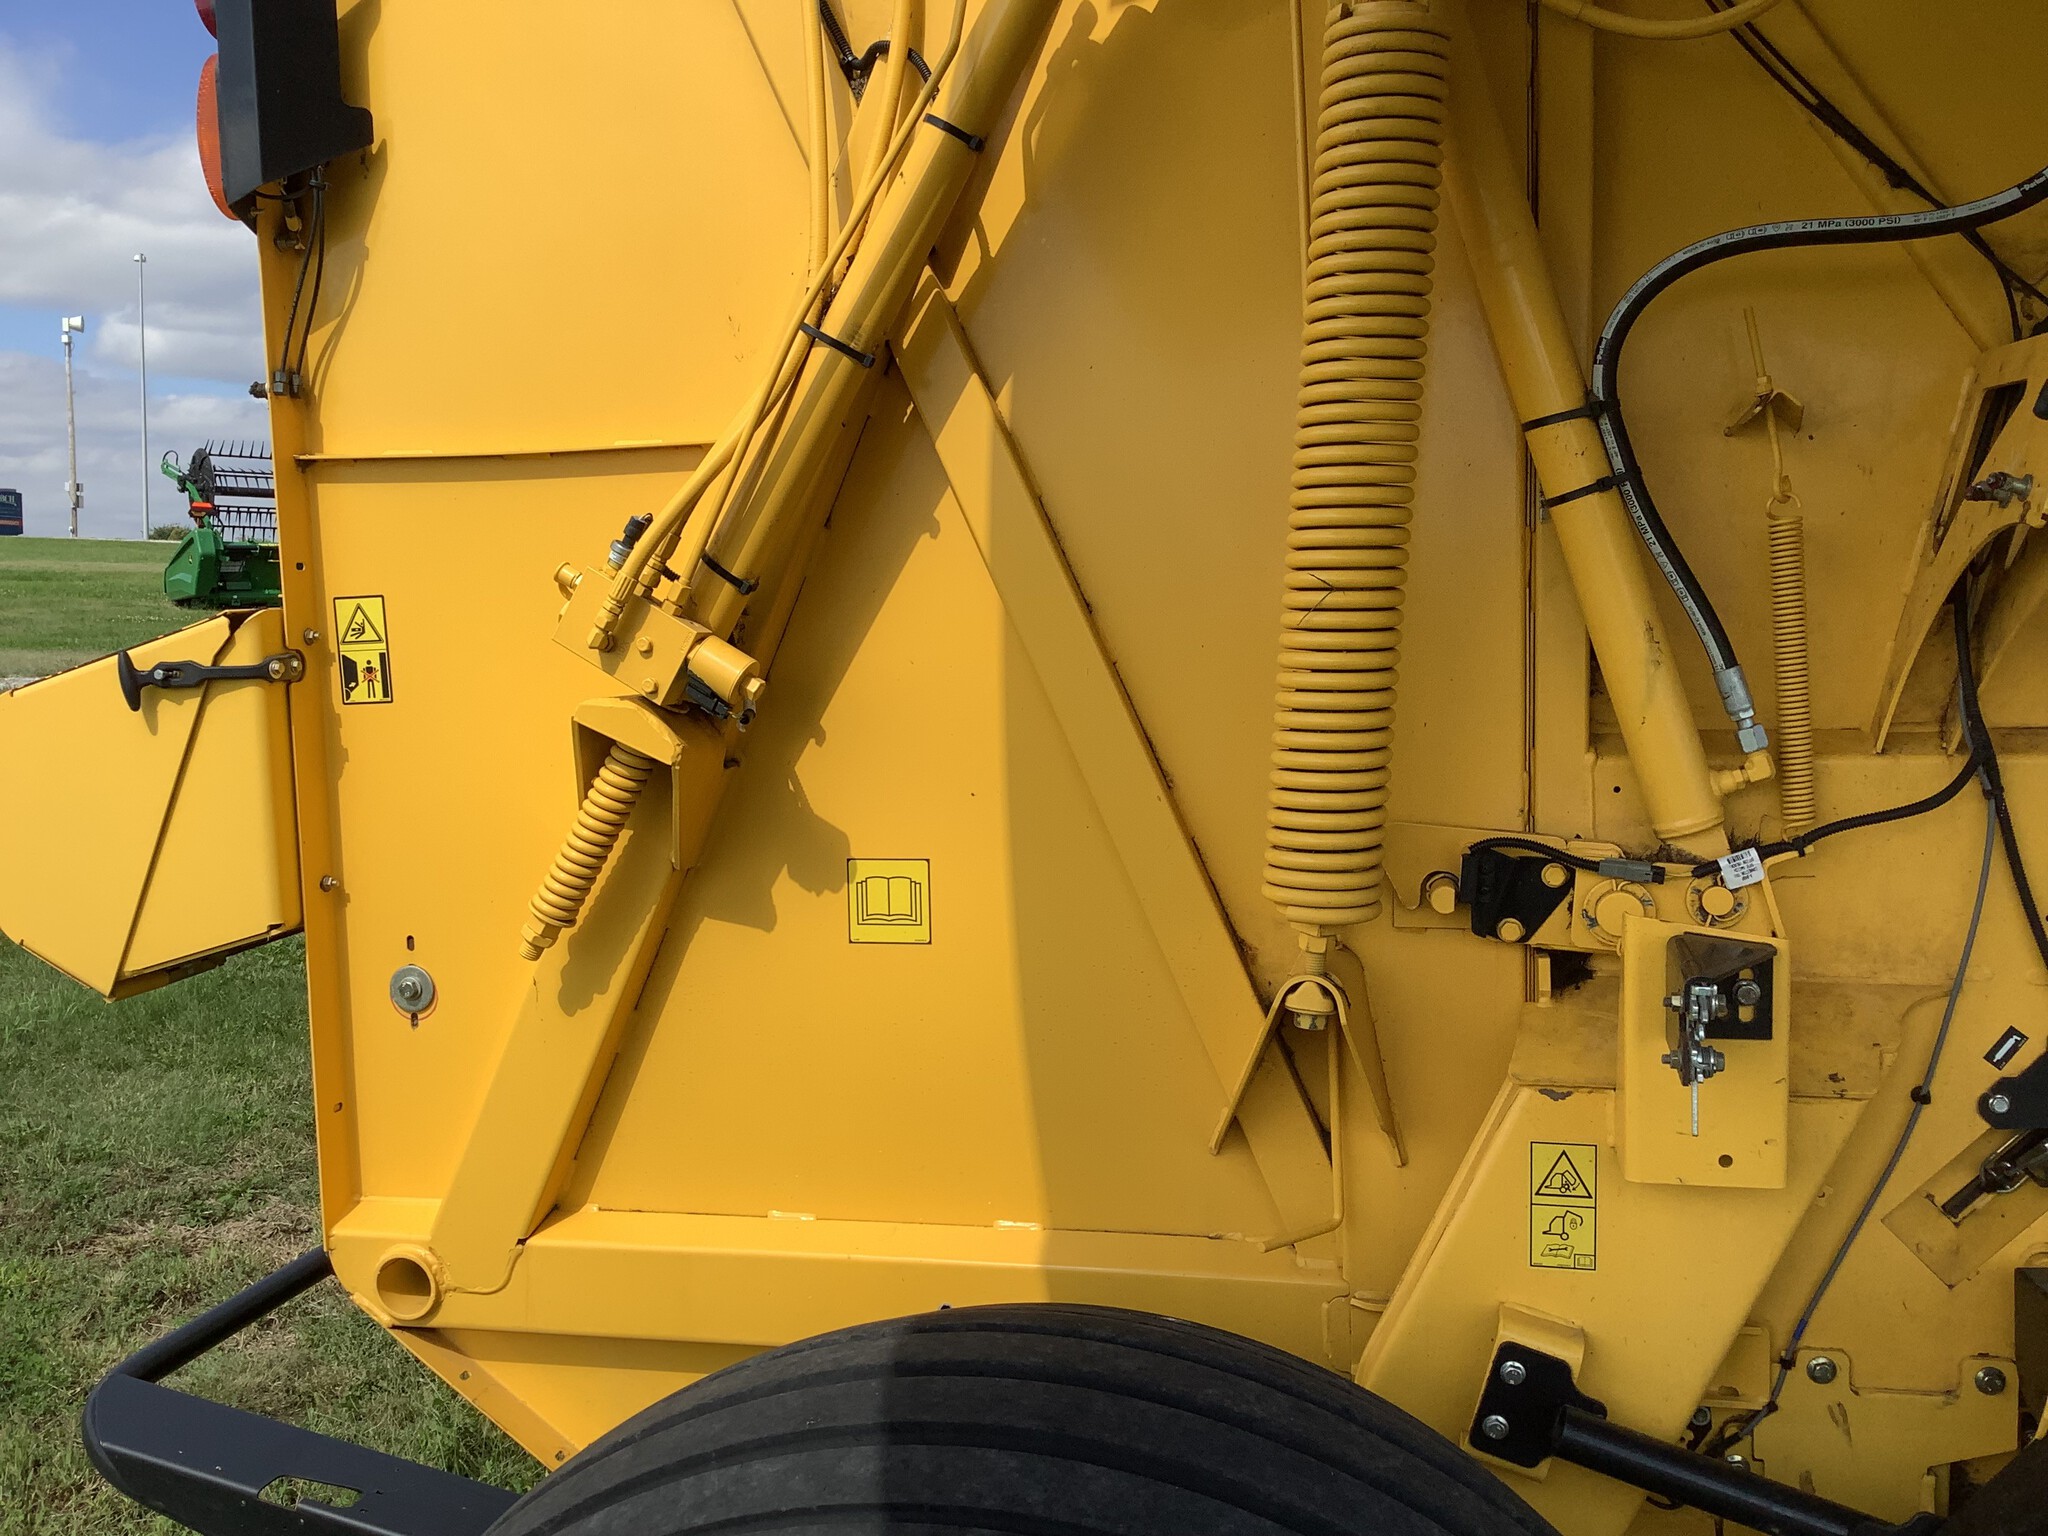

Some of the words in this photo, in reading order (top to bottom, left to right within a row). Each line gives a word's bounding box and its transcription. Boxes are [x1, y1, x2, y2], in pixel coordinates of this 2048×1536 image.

[1801, 222, 1813, 230] 21
[1818, 220, 1841, 229] MPa
[1845, 218, 1875, 228] (3000
[1879, 216, 1901, 225] PSI)
[1623, 489, 1639, 514] (3000
[1636, 515, 1650, 536] MPa
[1646, 537, 1656, 548] 21
